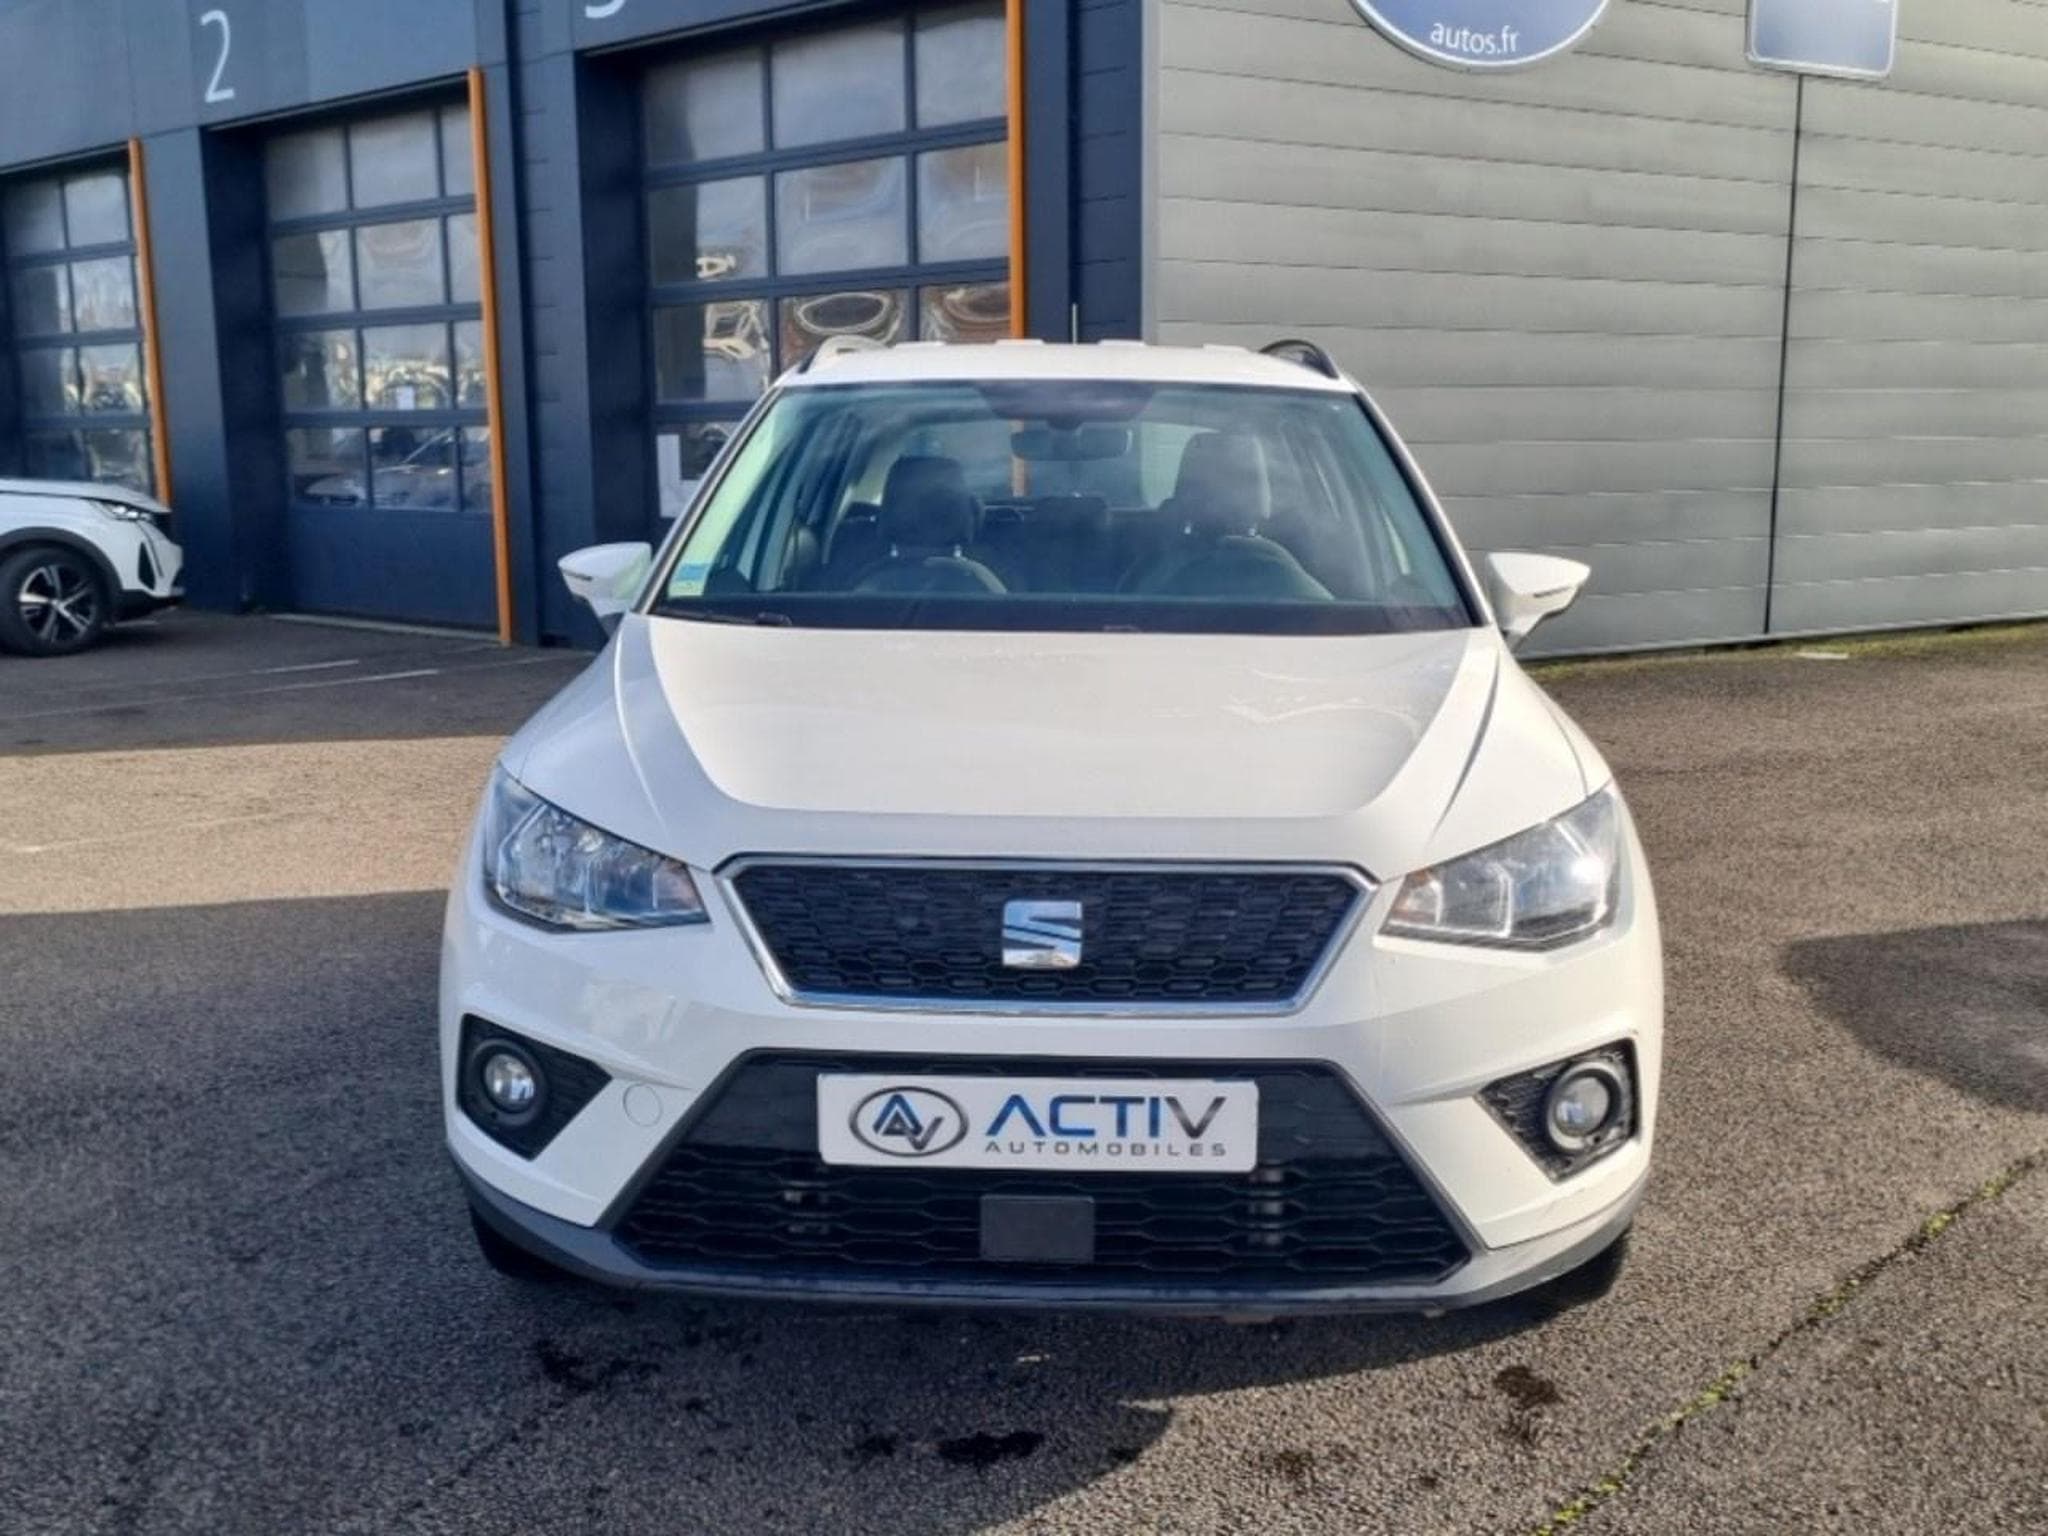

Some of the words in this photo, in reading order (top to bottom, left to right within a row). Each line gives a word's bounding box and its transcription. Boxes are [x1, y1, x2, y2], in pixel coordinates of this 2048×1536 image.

[201, 10, 235, 102] 2
[1431, 22, 1518, 54] autos.fr
[985, 1094, 1227, 1140] ACTIV
[985, 1141, 1226, 1156] AUTOMOBILES
